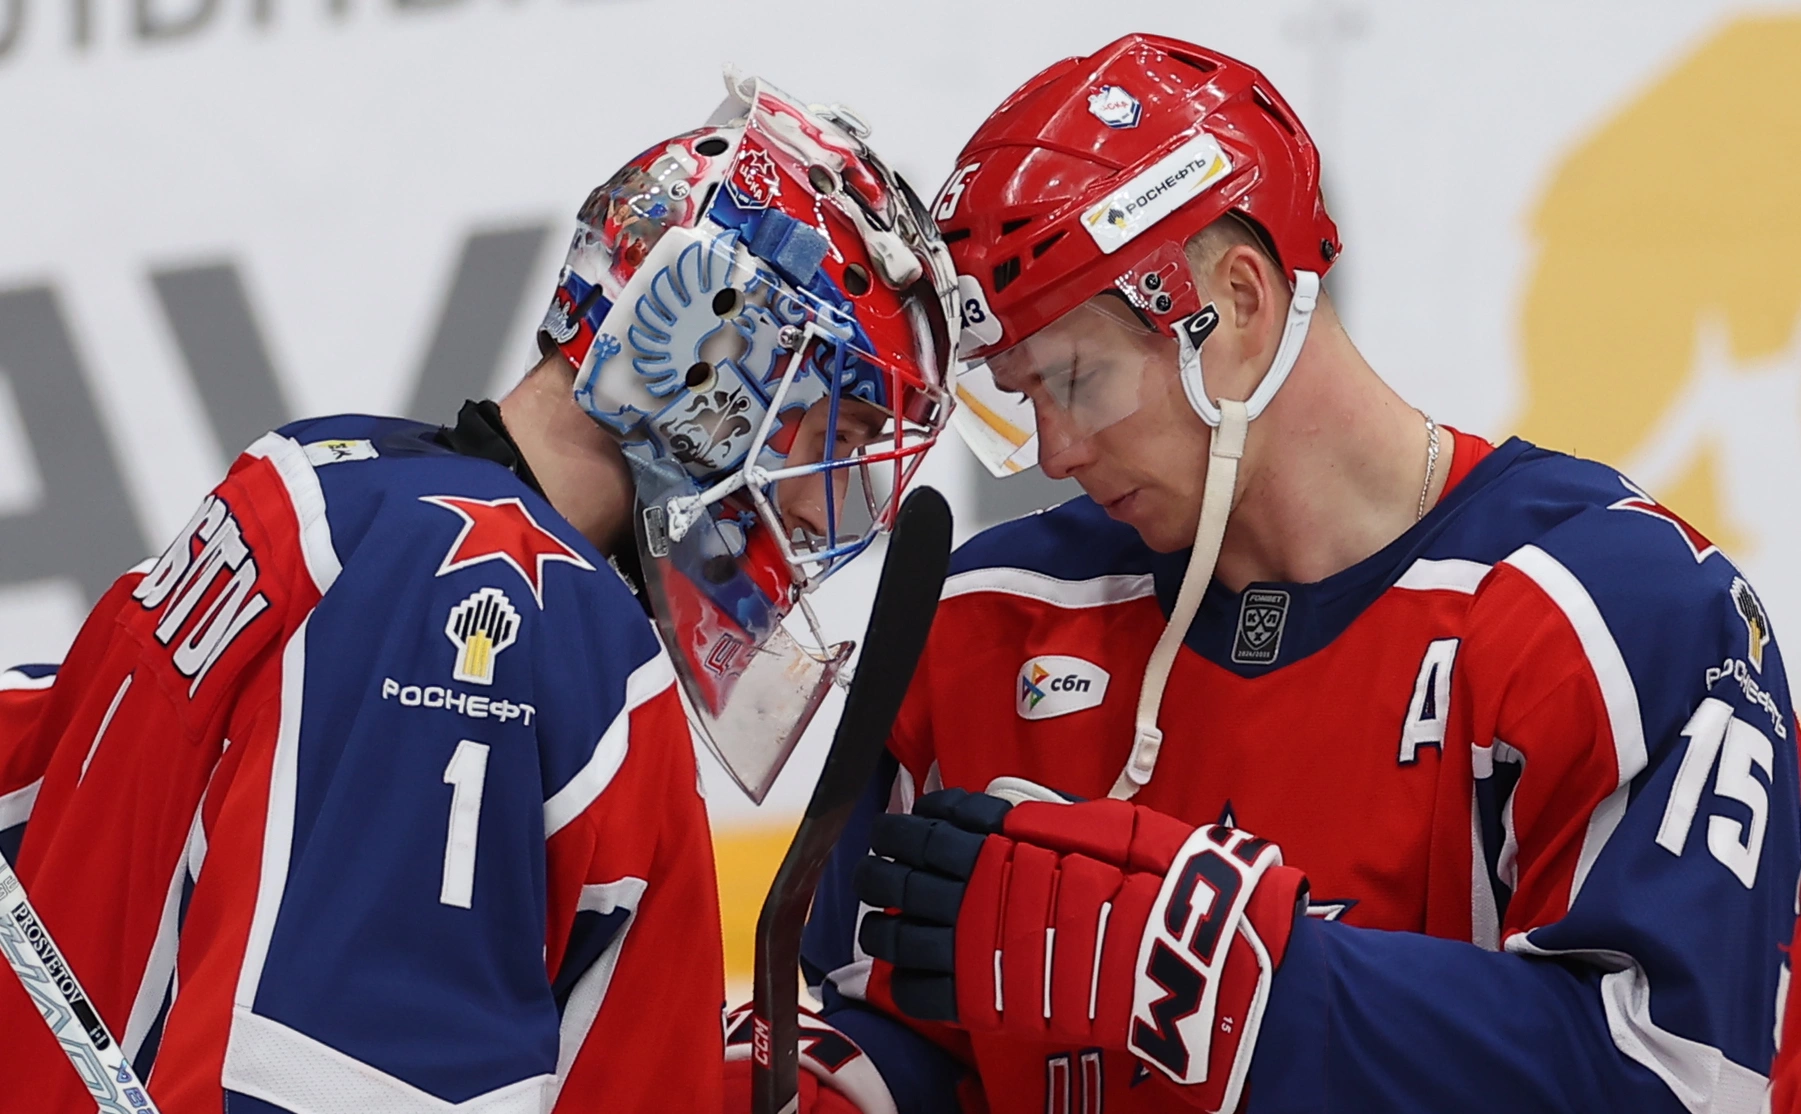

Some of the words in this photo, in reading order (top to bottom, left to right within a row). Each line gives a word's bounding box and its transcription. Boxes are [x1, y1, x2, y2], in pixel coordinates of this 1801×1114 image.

[739, 163, 763, 201] ЦСКА
[1125, 158, 1207, 215] РОСНЕФТЬ
[1050, 674, 1091, 692] сбп
[1398, 638, 1460, 763] A
[440, 739, 491, 909] 1
[1655, 697, 1774, 889] 15
[13, 902, 84, 1004] PROSVETOV
[754, 1018, 769, 1067] CCM
